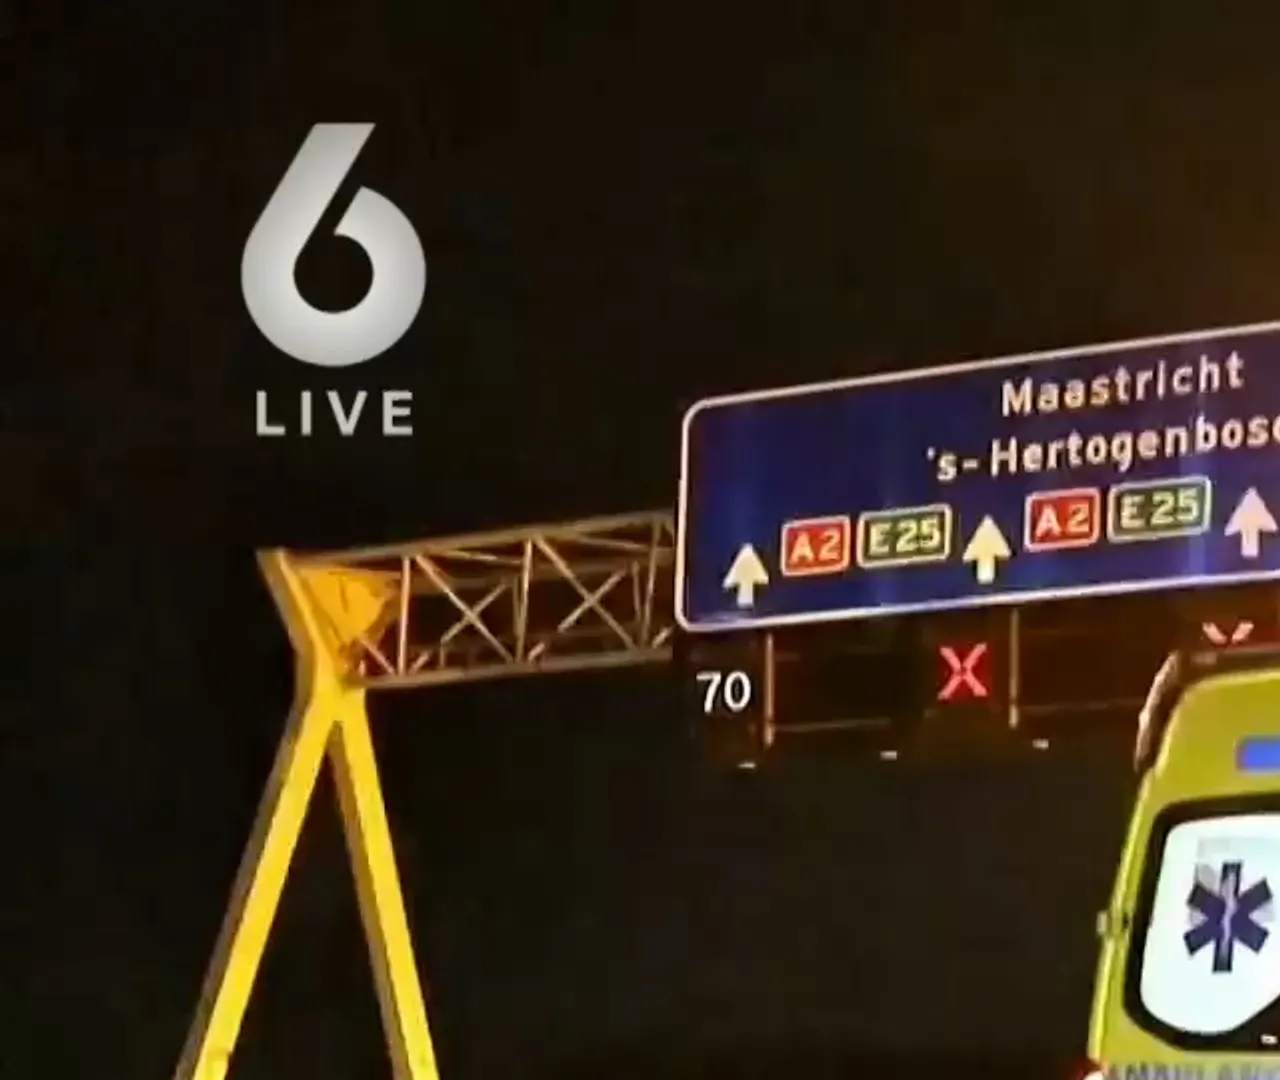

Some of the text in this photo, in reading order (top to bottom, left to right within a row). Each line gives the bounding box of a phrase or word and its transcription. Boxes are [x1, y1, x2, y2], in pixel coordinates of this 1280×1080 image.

[1002, 350, 1245, 417] Maastricht
[789, 527, 842, 563] A2
[1033, 500, 1092, 538] A2
[696, 671, 752, 713] 70
